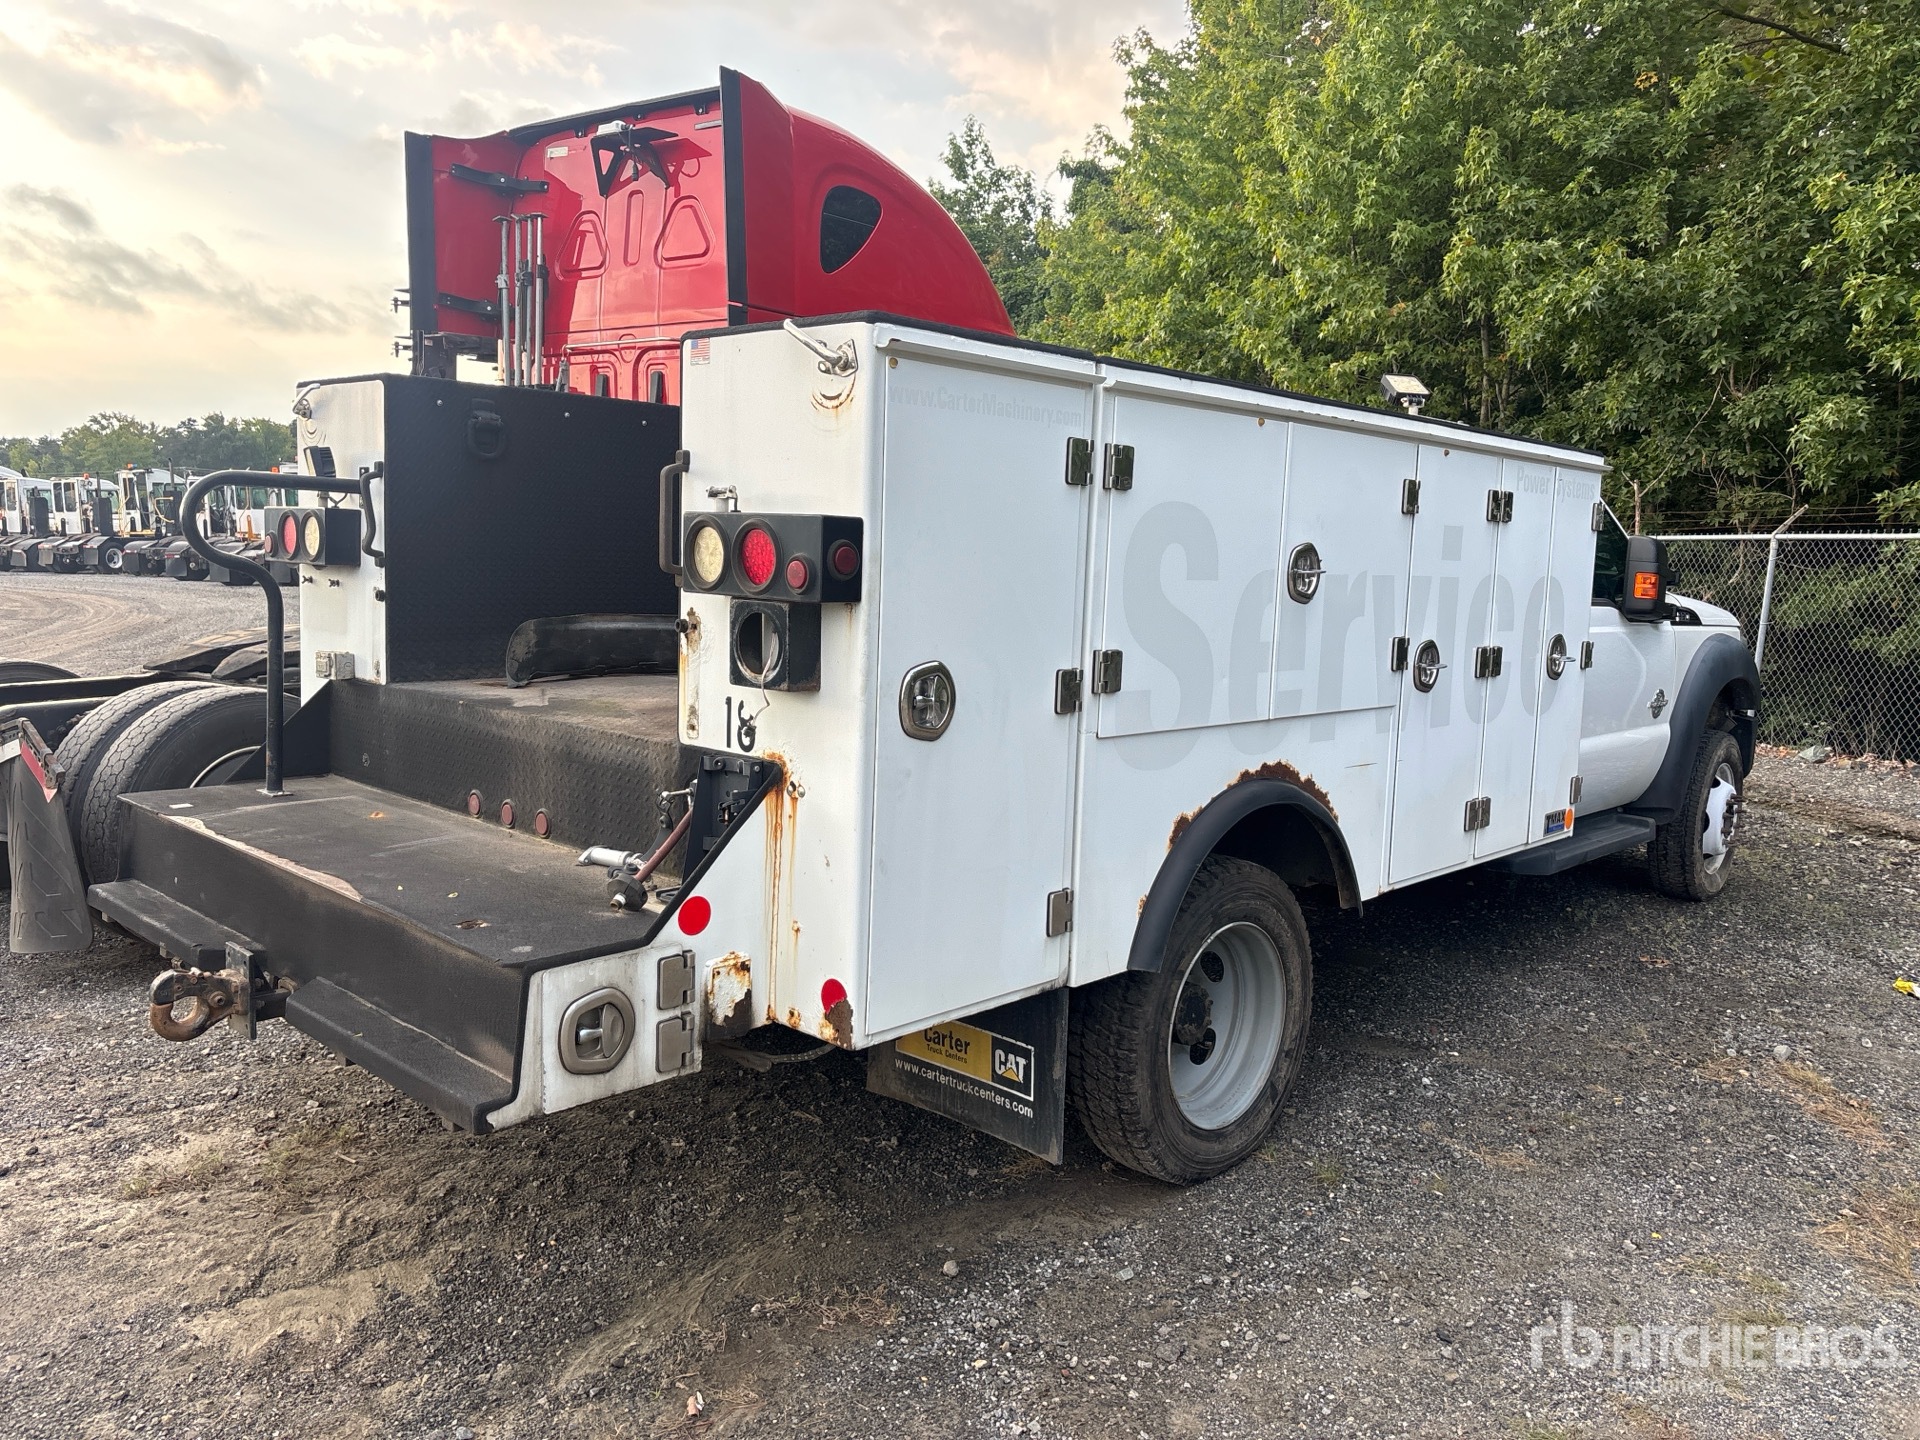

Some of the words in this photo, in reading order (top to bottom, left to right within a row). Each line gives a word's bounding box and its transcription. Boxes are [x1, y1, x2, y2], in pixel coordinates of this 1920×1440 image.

[1516, 465, 1550, 495] Power
[1113, 500, 1567, 772] Service
[923, 1027, 971, 1055] Carter
[926, 1044, 944, 1056] Truck
[944, 1049, 968, 1064] Centers
[994, 1049, 1028, 1084] CAT
[894, 1057, 1034, 1119] www.cartertruckcenters.com
